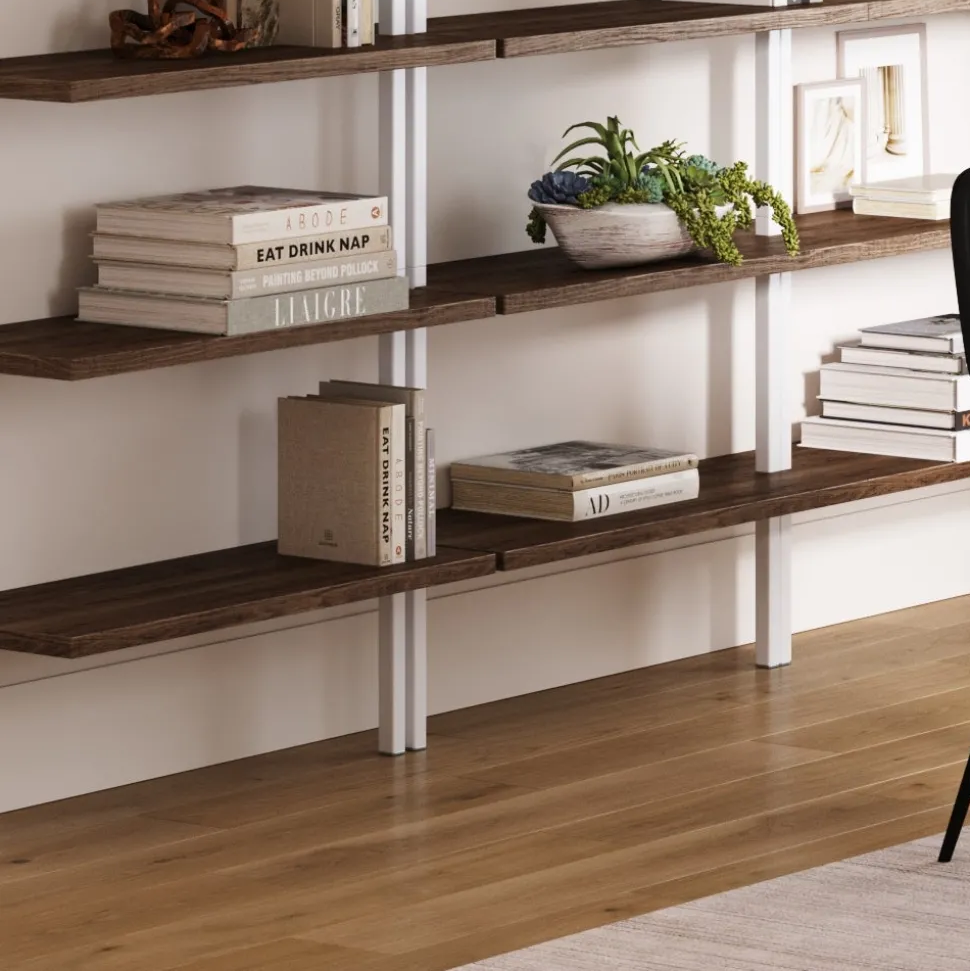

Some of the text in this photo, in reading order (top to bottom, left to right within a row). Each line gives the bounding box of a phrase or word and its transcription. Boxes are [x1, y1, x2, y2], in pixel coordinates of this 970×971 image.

[286, 208, 348, 231] ABODE
[256, 234, 371, 263] EAT DRINK NAP
[262, 270, 302, 289] PAINTING
[304, 265, 339, 283] BEYOND
[340, 259, 380, 279] POLLOCK
[274, 285, 367, 327] LIAIGRE
[395, 458, 404, 521] ABODE
[585, 493, 610, 517] AD
